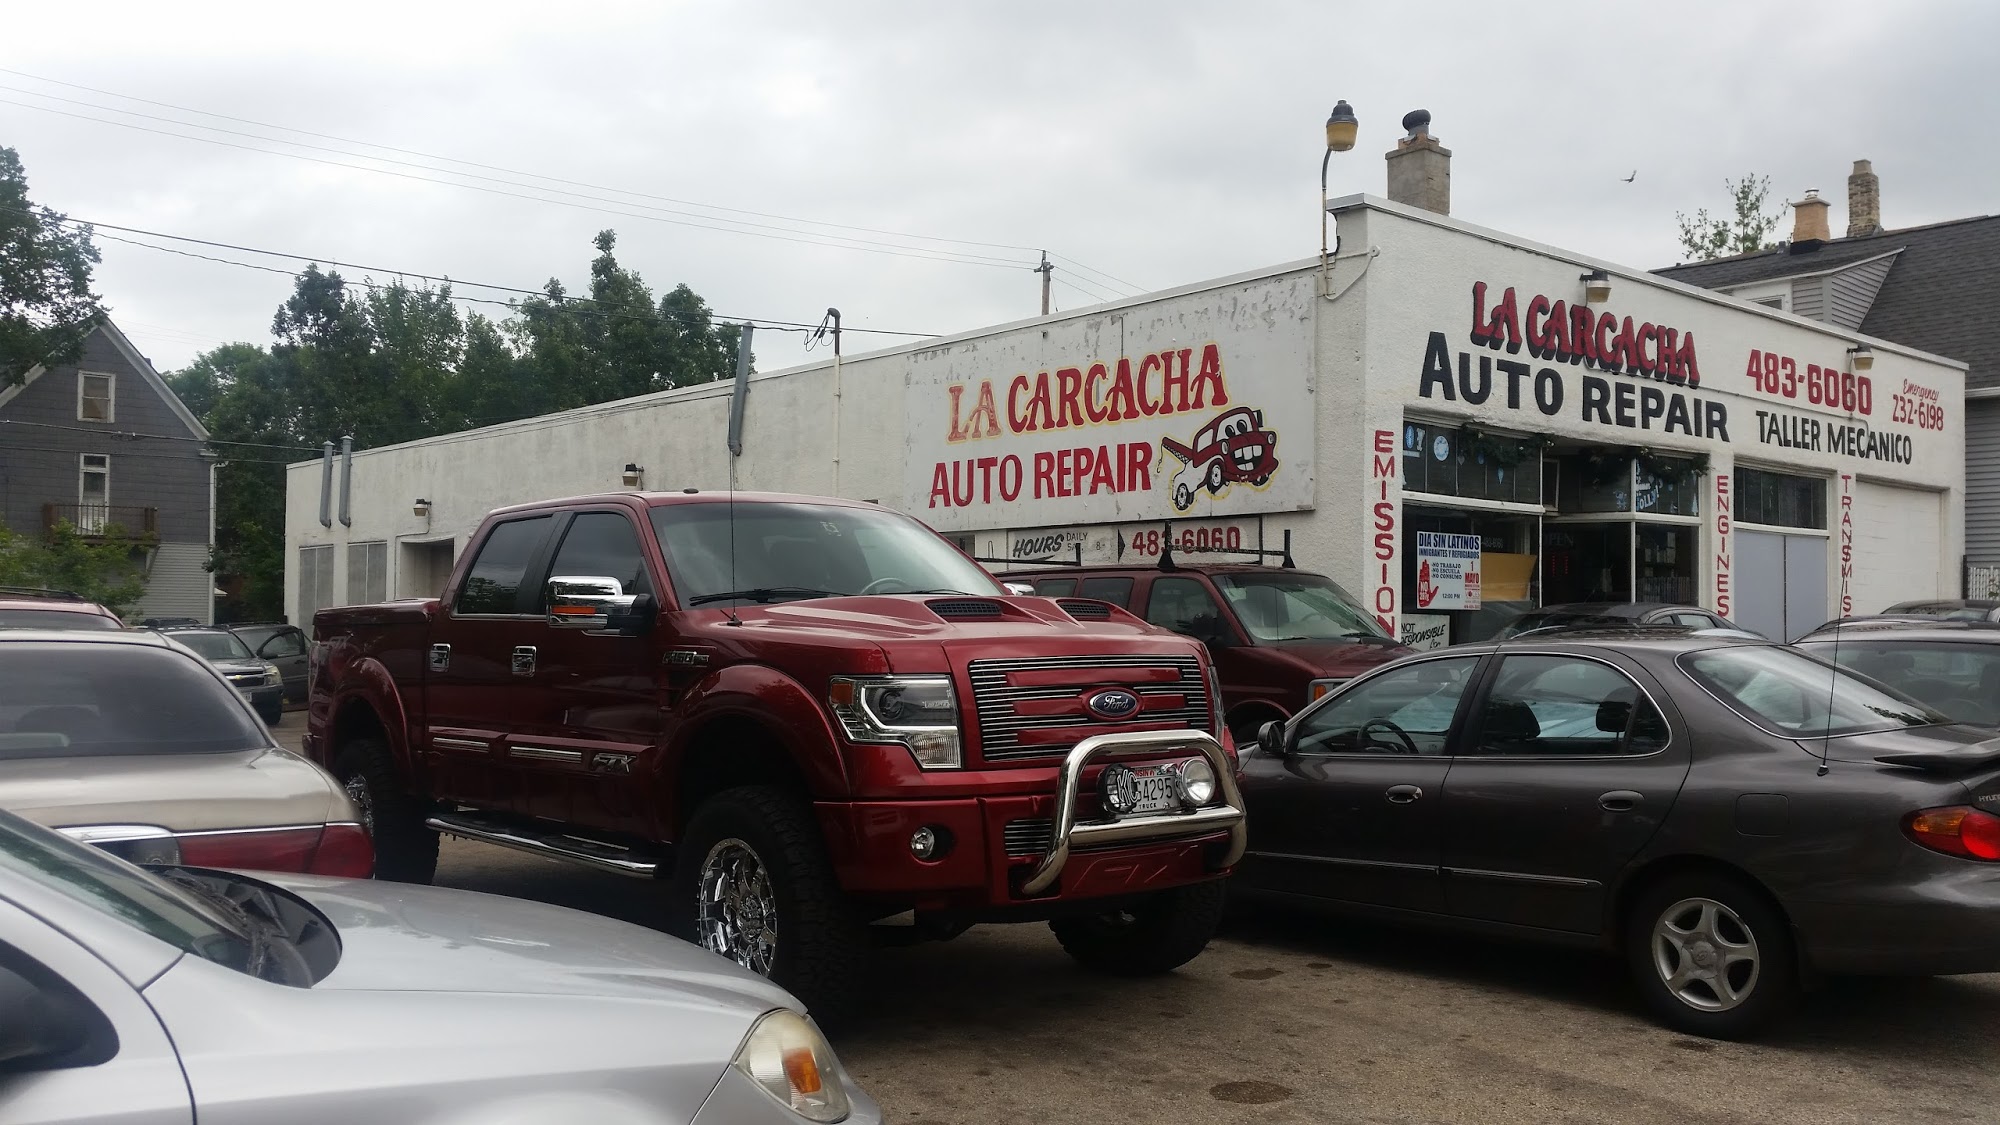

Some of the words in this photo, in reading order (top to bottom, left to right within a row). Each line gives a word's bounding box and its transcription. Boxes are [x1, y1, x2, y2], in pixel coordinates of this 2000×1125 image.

[1470, 281, 1523, 354] LA
[1525, 294, 1700, 389] CARCACHA
[947, 380, 1001, 441] LA
[1007, 343, 1229, 433] CARCACHA
[1419, 331, 1564, 416] AUTO
[1582, 375, 1731, 443] REPAIR
[1746, 349, 1873, 416] 483-6060
[1902, 378, 1940, 404] Emergency
[1892, 394, 1944, 431] 232-6198
[1755, 410, 1821, 452] TALLER
[1827, 422, 1913, 465] MECANICO
[928, 454, 1023, 509] AUTO
[1033, 441, 1153, 499] REPAIR
[1012, 532, 1065, 558] HOURS
[1066, 532, 1088, 543] DAILY
[1419, 533, 1431, 547] DIA
[1434, 534, 1446, 548] SIN
[1448, 535, 1479, 550] LATINOS
[1452, 550, 1479, 559] REFUGIADOS
[1716, 475, 1730, 618] ENGINES
[1841, 475, 1853, 618] TRANSMIS
[1465, 573, 1479, 583] MAYO
[1470, 561, 1474, 571] 1
[1401, 623, 1415, 633] NOT
[1104, 695, 1128, 709] Ford
[1117, 769, 1139, 806] KC
